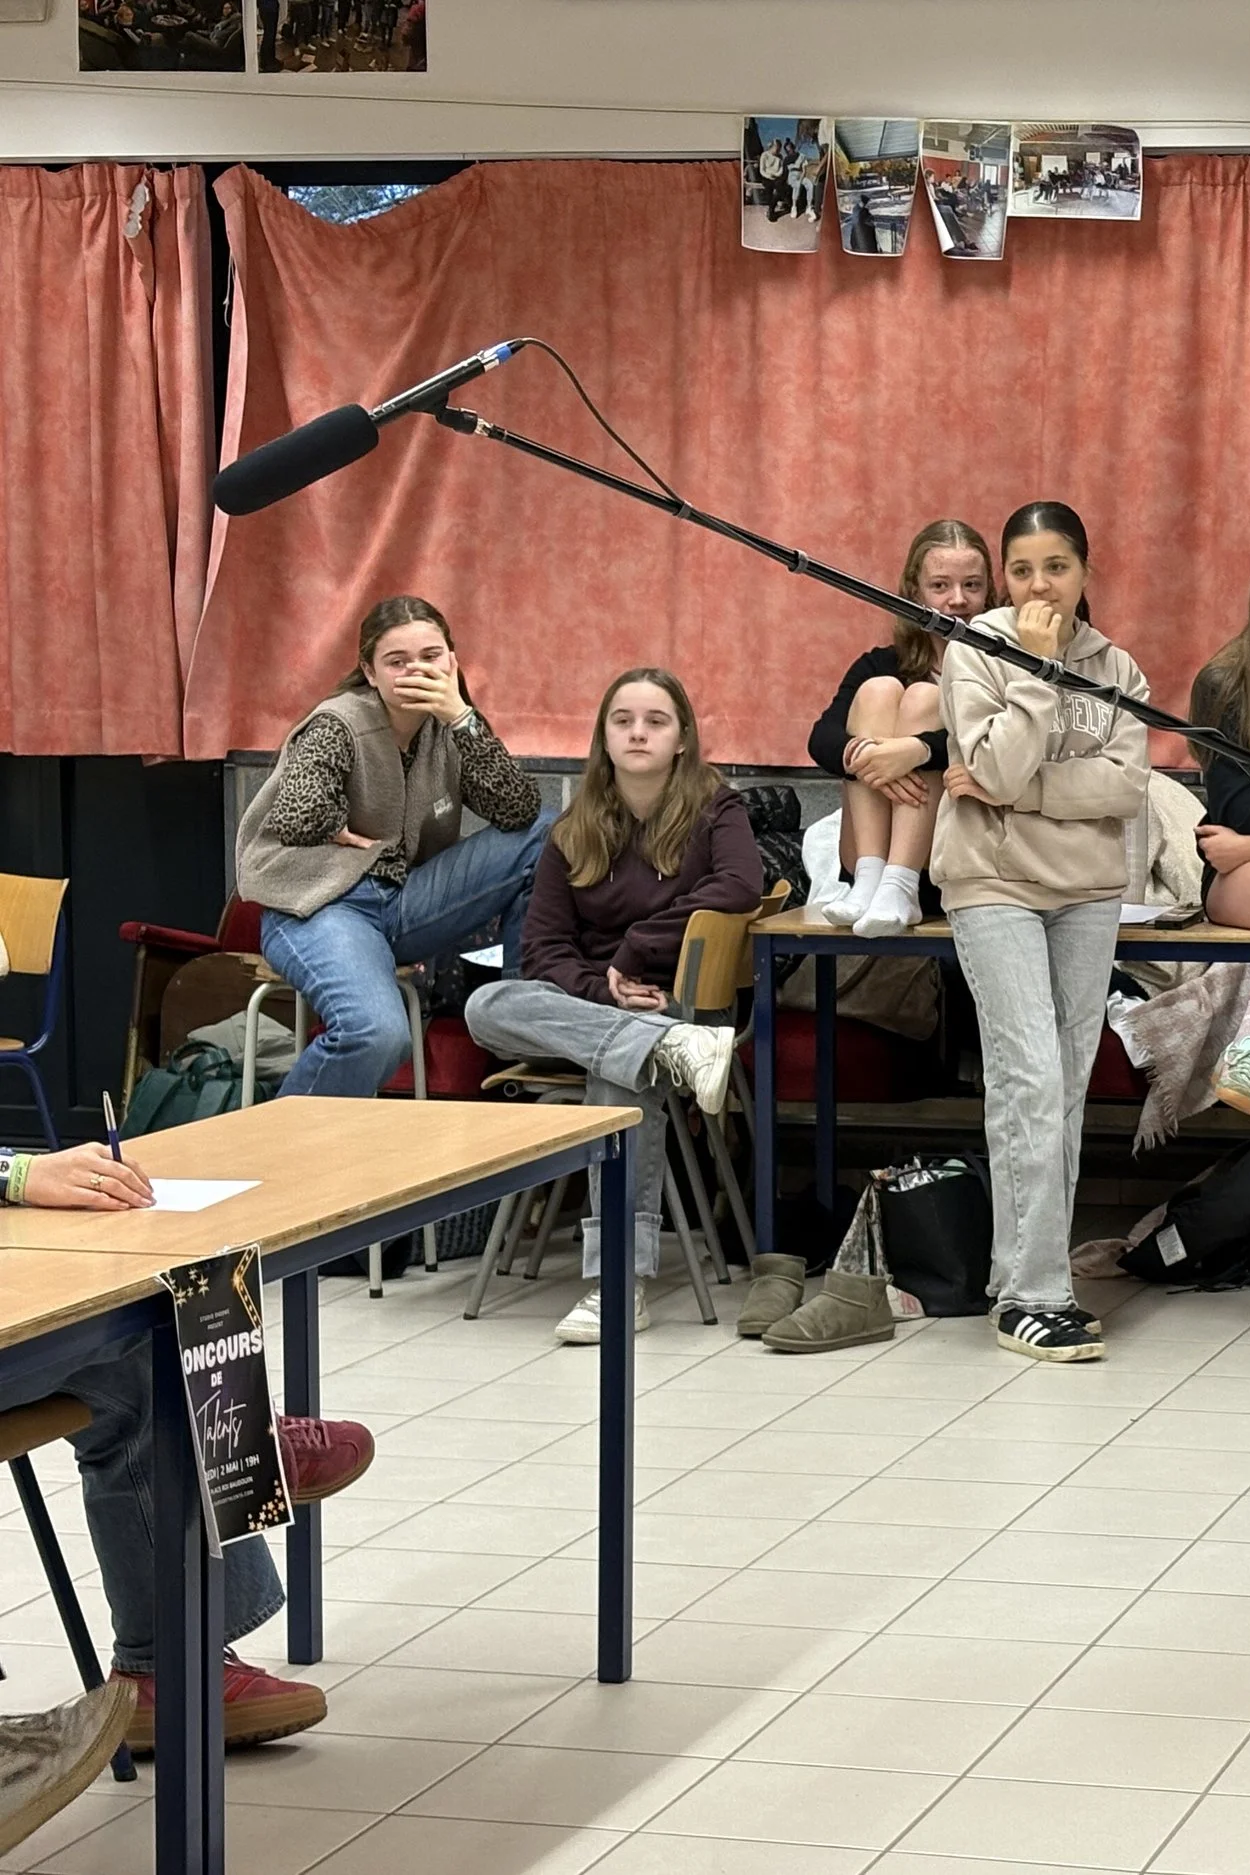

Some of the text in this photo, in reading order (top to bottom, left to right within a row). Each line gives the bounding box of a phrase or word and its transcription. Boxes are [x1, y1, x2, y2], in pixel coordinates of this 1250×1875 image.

[183, 1328, 263, 1376] ONCOURS
[211, 1370, 223, 1388] DE
[196, 1389, 247, 1466] Talents
[245, 1454, 261, 1468] 19H
